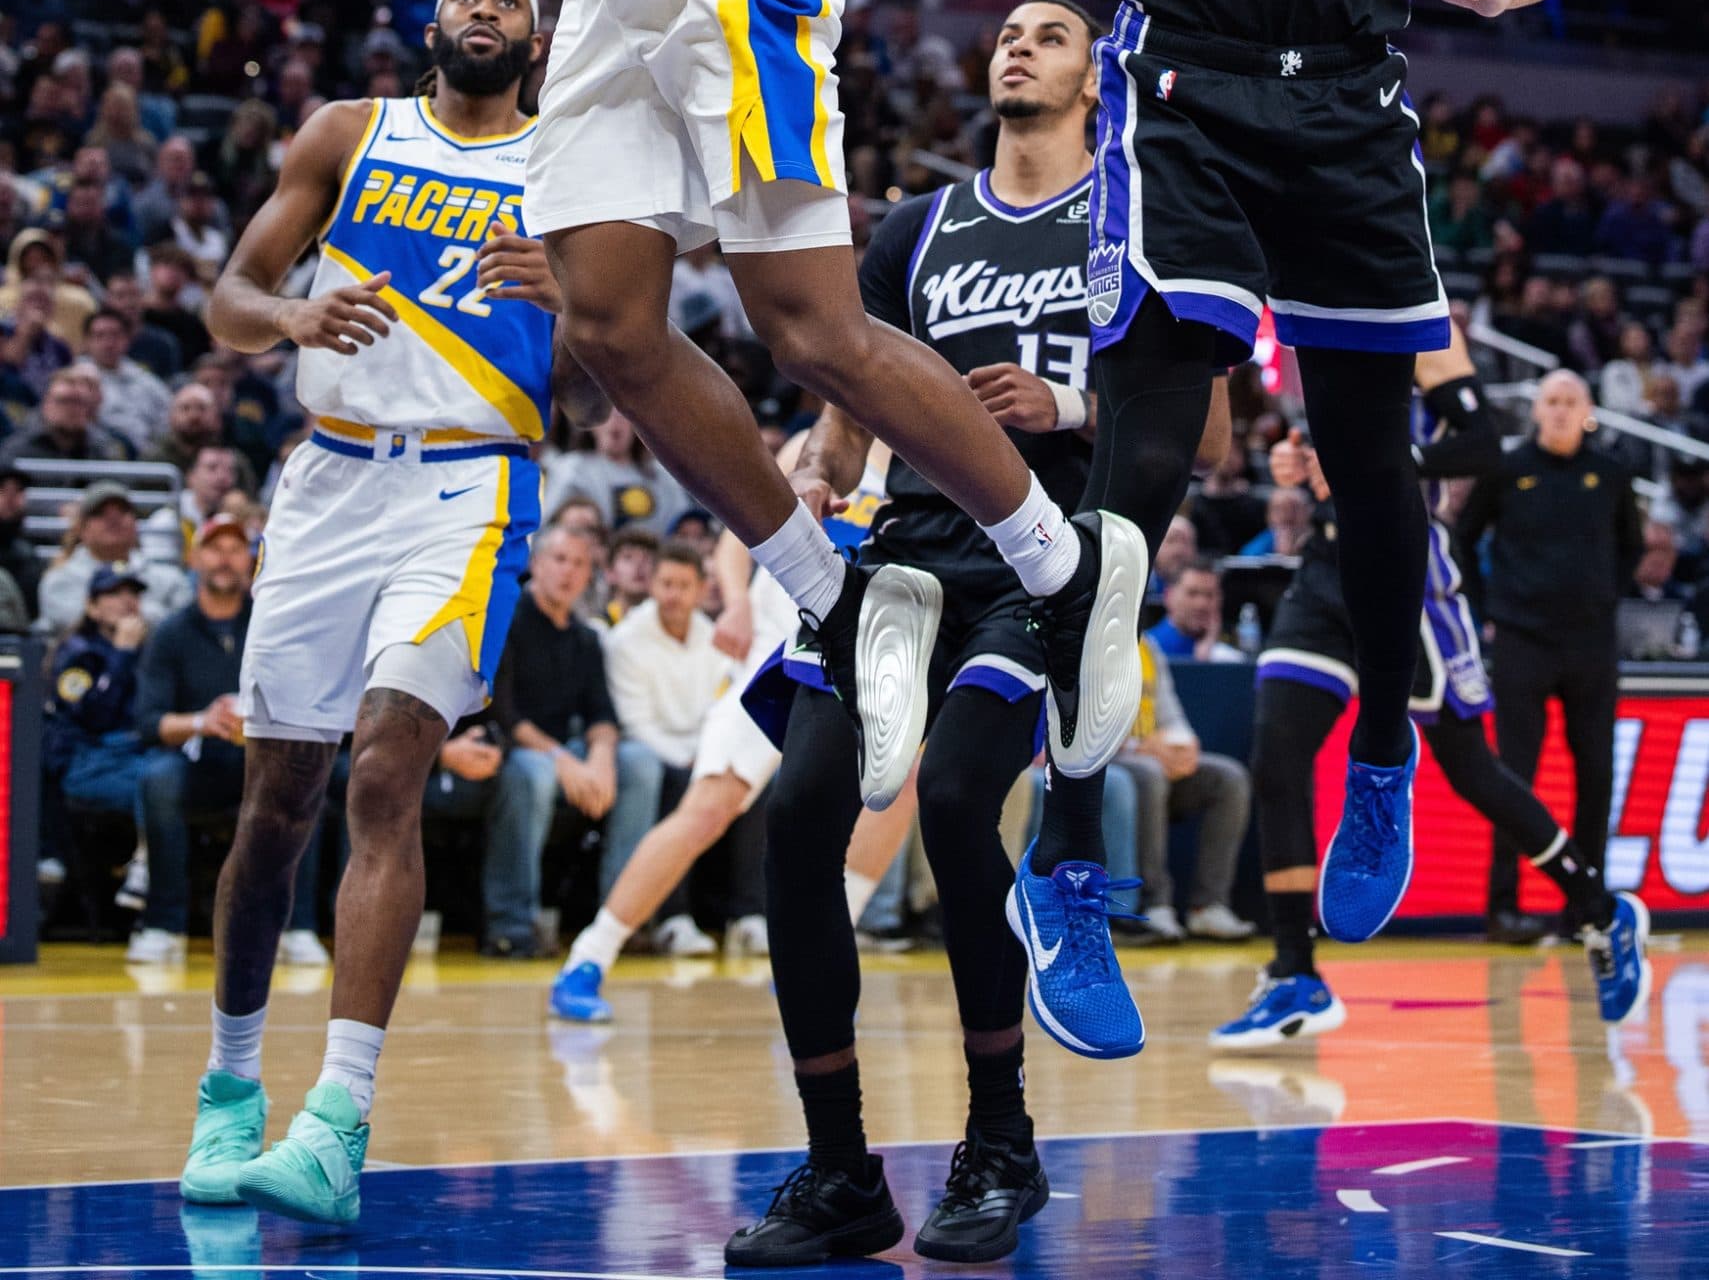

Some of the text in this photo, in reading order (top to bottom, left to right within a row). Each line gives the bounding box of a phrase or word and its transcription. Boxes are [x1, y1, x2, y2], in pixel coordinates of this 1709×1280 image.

[351, 168, 524, 243] PACERS
[922, 259, 1088, 336] Kings
[1016, 332, 1091, 391] 13
